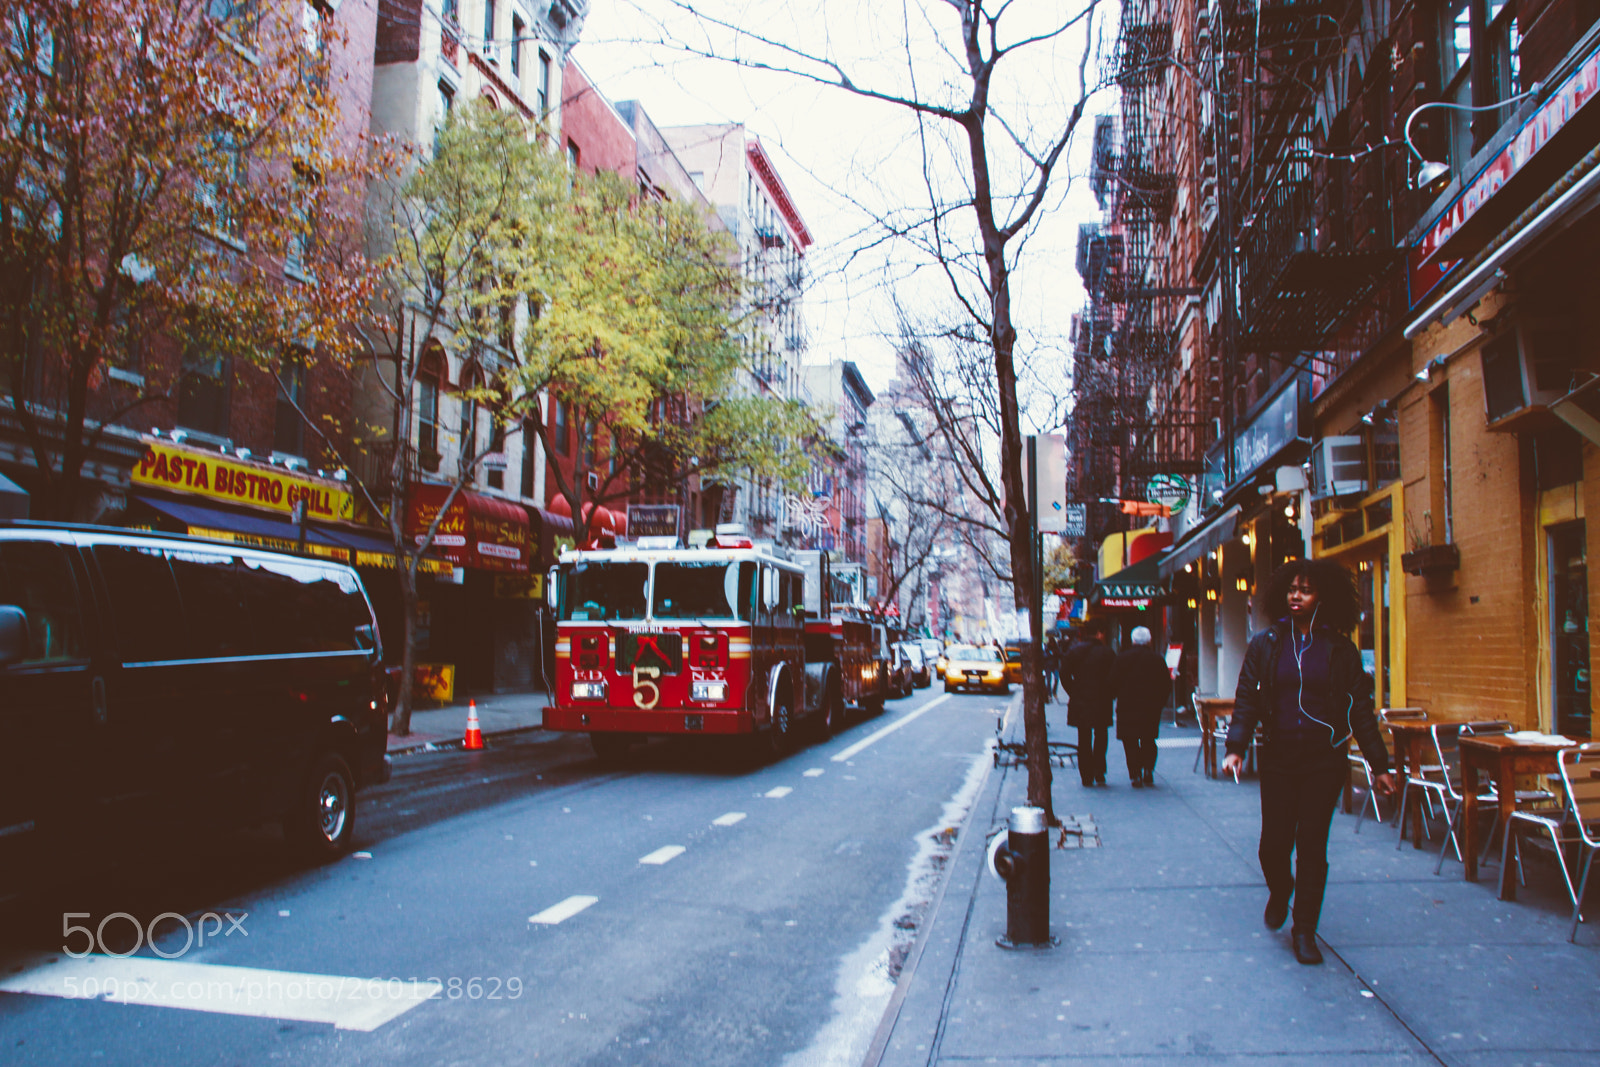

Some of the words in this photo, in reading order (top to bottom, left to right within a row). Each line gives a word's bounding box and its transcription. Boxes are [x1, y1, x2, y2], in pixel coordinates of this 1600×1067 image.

[140, 450, 209, 490] PASTA
[214, 466, 283, 505] BISTRO
[287, 484, 334, 516] GRILL
[1151, 488, 1187, 498] Heneken
[632, 666, 661, 710] 5
